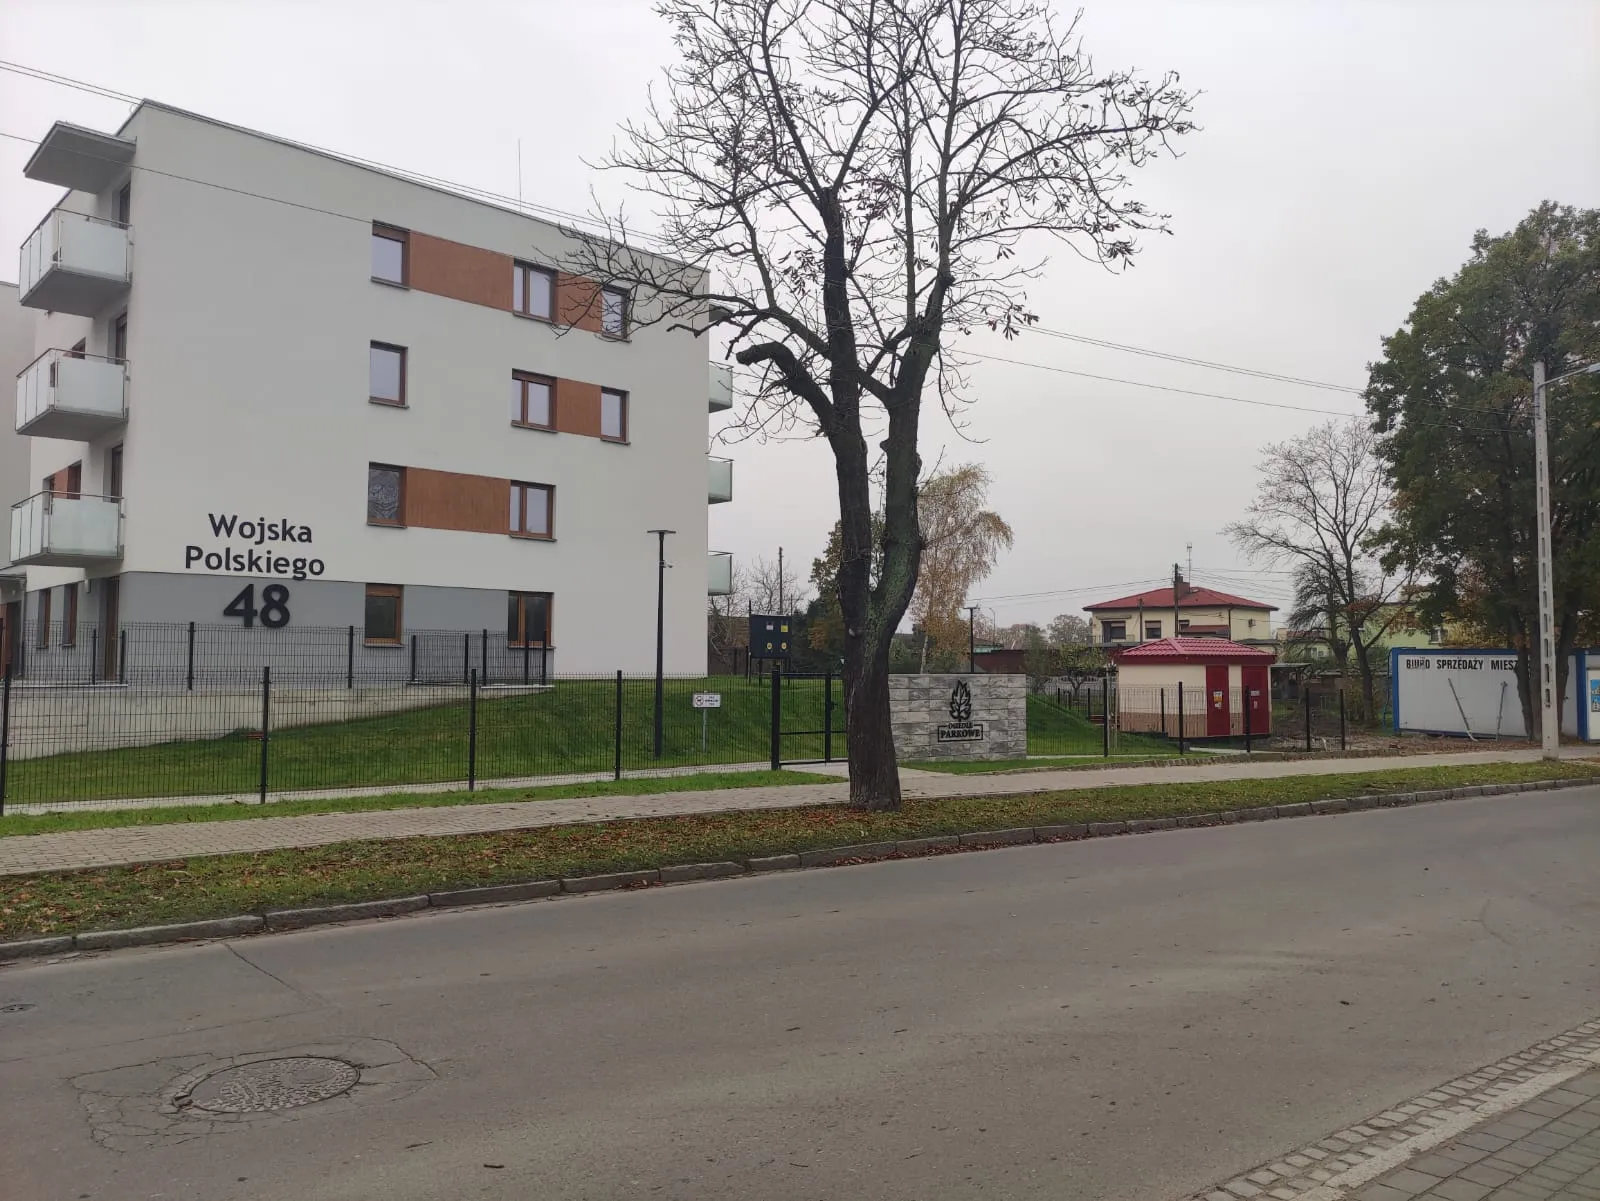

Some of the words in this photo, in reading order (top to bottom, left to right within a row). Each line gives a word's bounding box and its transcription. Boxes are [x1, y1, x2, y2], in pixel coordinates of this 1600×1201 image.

[208, 513, 312, 545] Wojska
[185, 545, 325, 581] Polskiego
[223, 583, 290, 628] 48
[1406, 659, 1430, 670] BIURO
[1436, 657, 1484, 670] SPRZEDAŻY
[940, 729, 981, 739] PARKOWE
